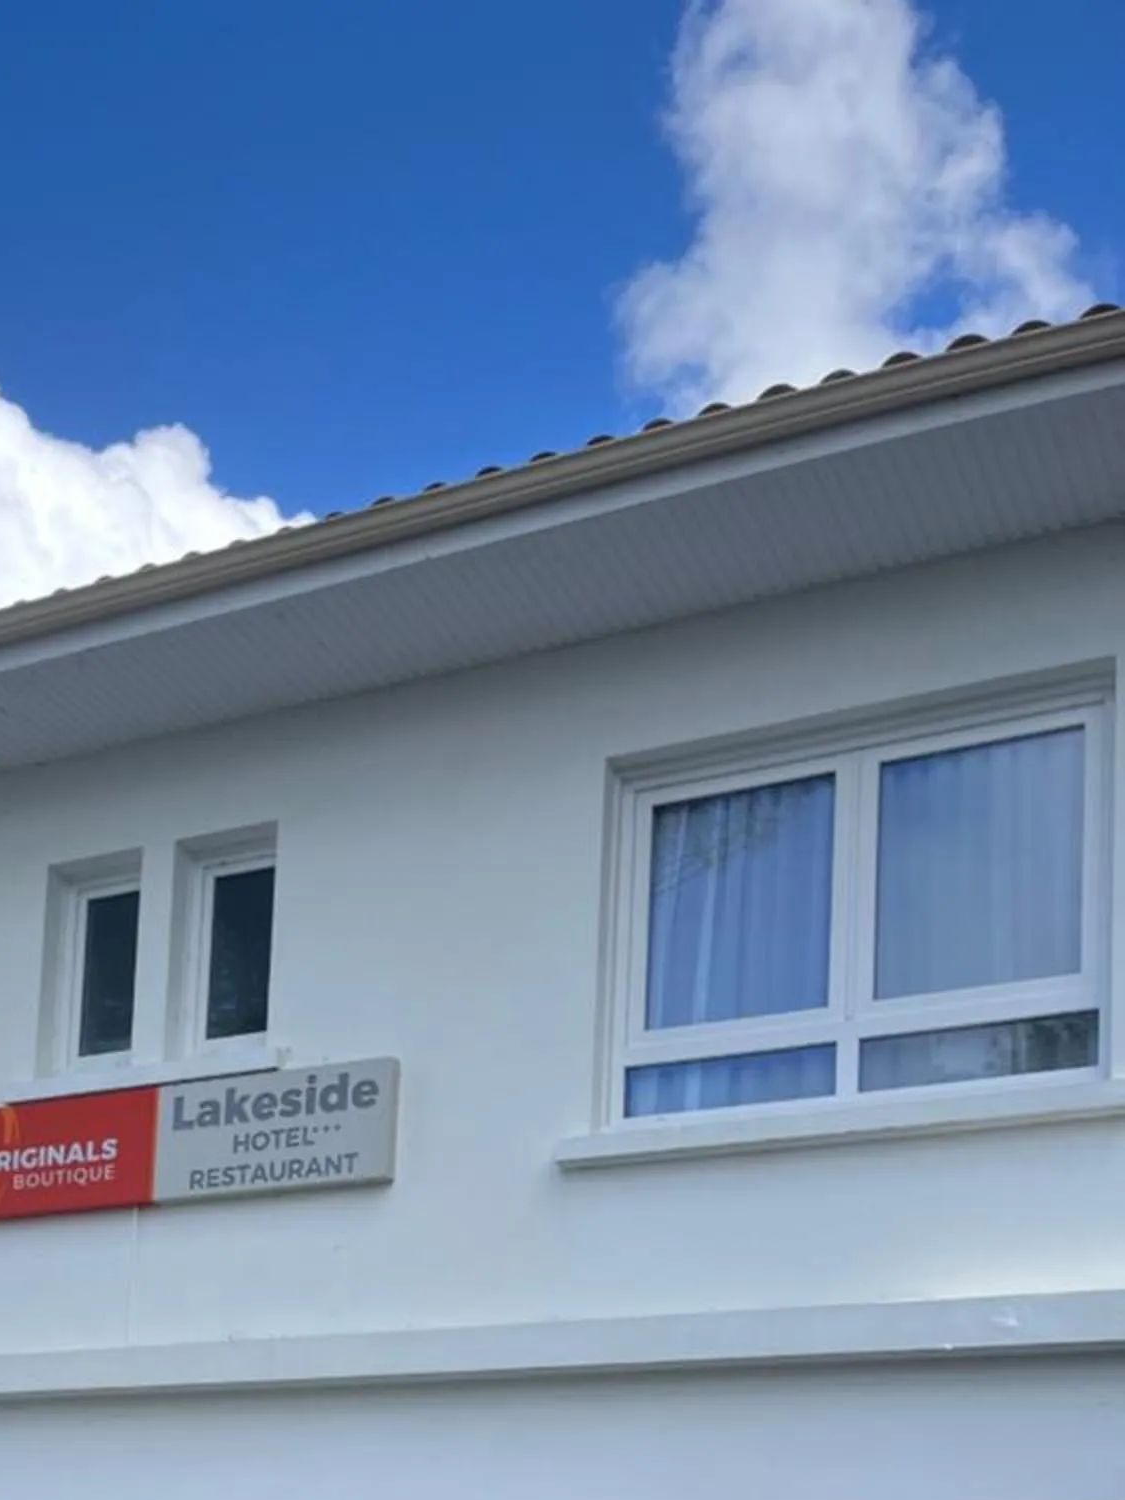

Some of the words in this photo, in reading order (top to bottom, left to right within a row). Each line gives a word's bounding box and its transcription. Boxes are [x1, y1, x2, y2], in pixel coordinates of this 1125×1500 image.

[172, 1073, 379, 1131] Lakeside
[12, 1164, 116, 1190] BOUTIQUE
[189, 1152, 358, 1190] RESTAURANT
